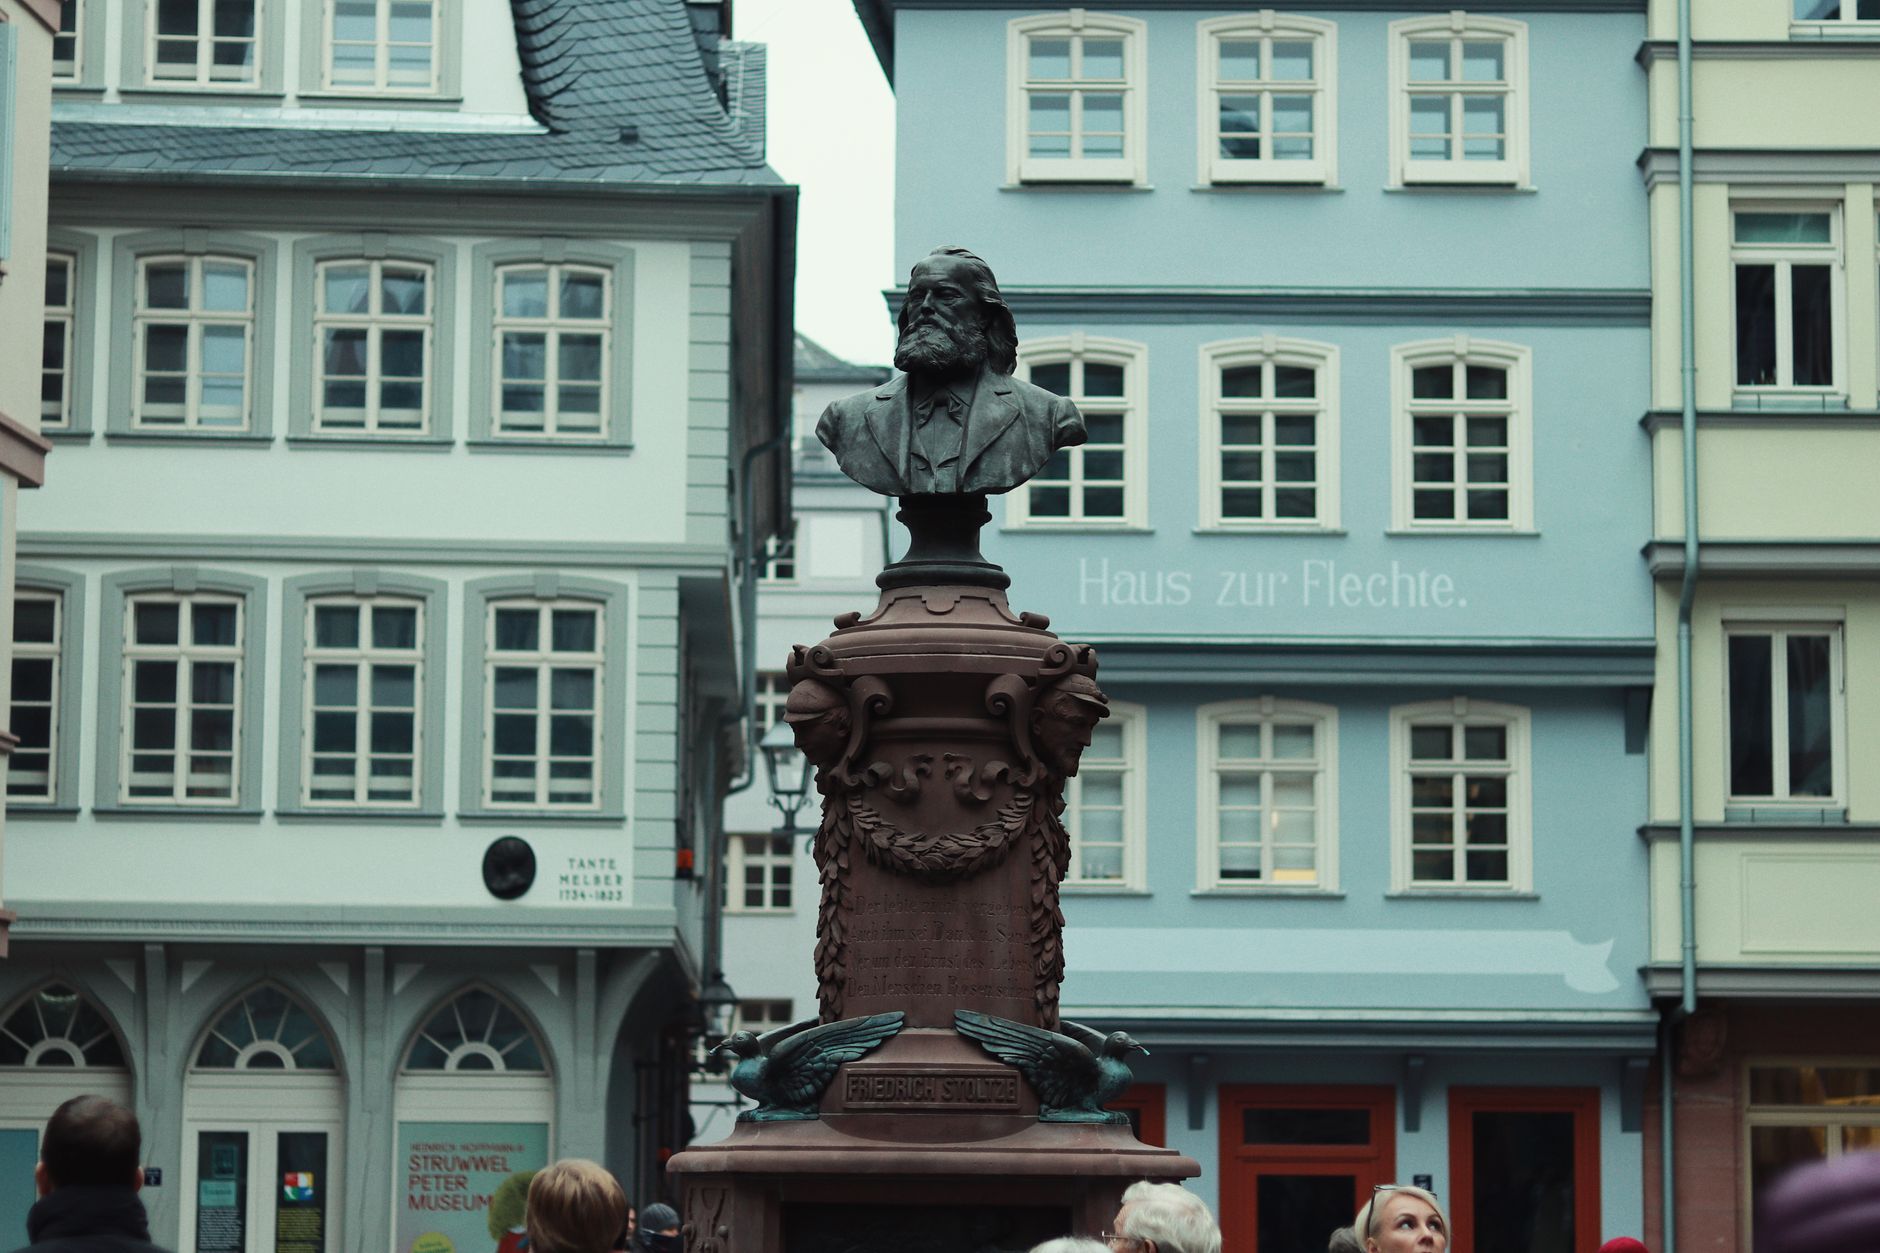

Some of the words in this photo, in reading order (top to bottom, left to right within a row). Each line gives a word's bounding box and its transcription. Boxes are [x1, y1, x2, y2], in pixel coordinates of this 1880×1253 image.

[1079, 557, 1192, 606] Haus
[1216, 571, 1289, 607] zur
[1302, 559, 1468, 608] Flechte.
[568, 857, 617, 870] TANTE
[559, 874, 624, 886] MELBER
[850, 1076, 934, 1100] FRIEDRICH
[942, 1077, 1017, 1101] STOLTZE
[408, 1154, 512, 1173] STRUWWEL
[408, 1174, 468, 1192] PETER
[408, 1194, 496, 1212] MUSEUM
